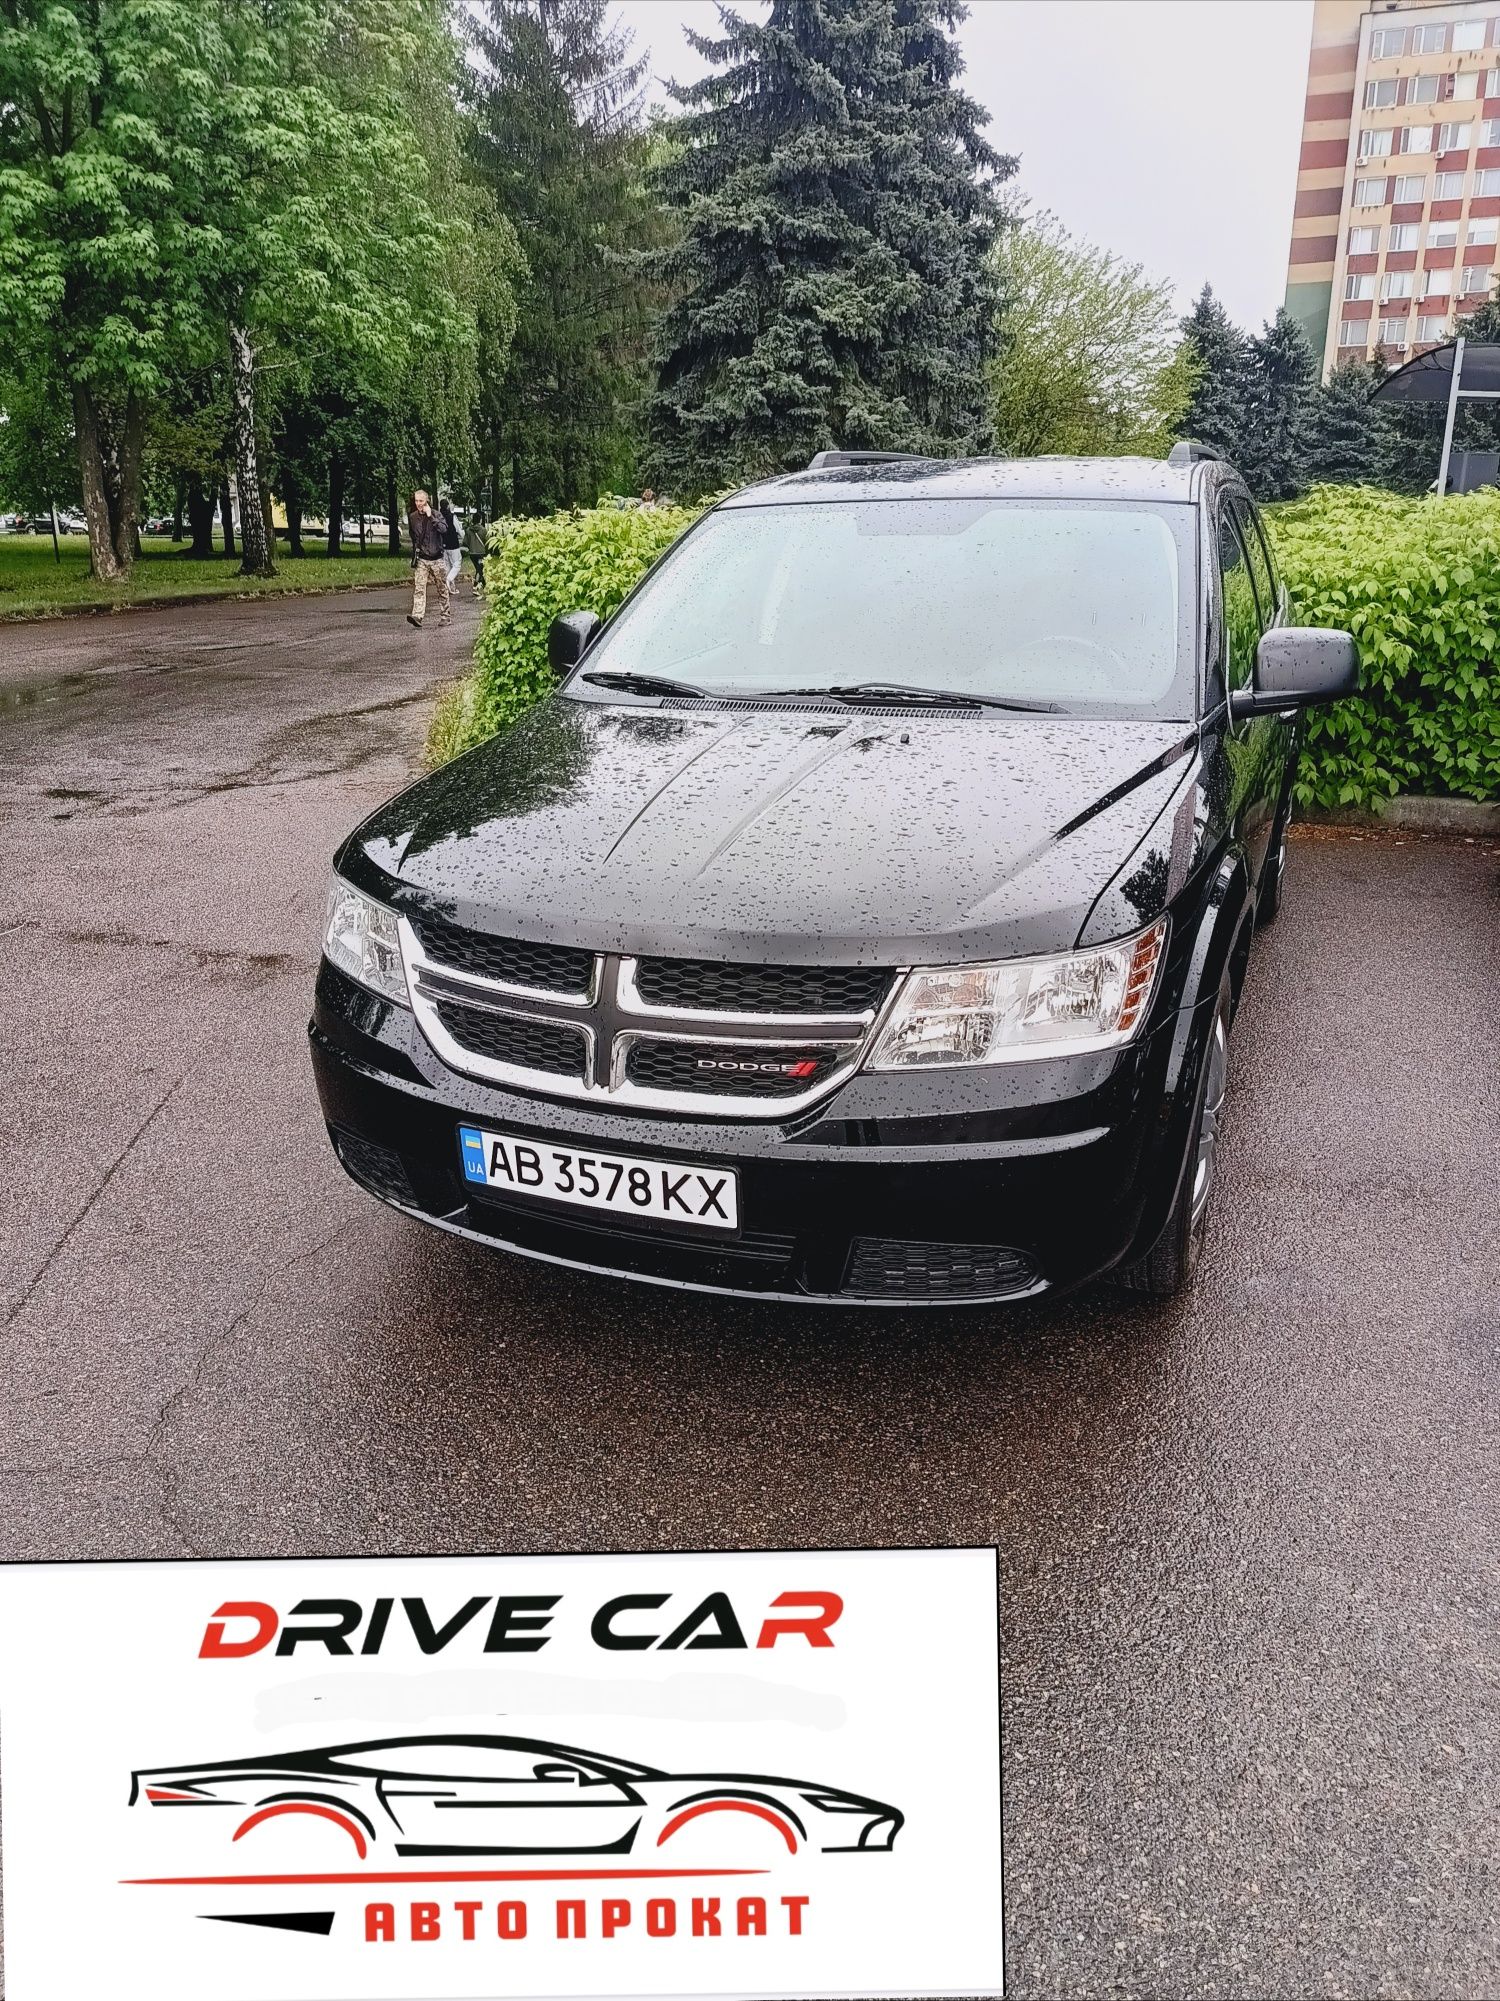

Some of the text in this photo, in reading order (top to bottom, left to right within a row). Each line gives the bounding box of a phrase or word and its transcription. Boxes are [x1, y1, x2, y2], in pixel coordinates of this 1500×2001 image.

[697, 1059, 800, 1073] DODGE
[467, 1161, 485, 1175] UA
[489, 1140, 729, 1220] AB 3578 KX
